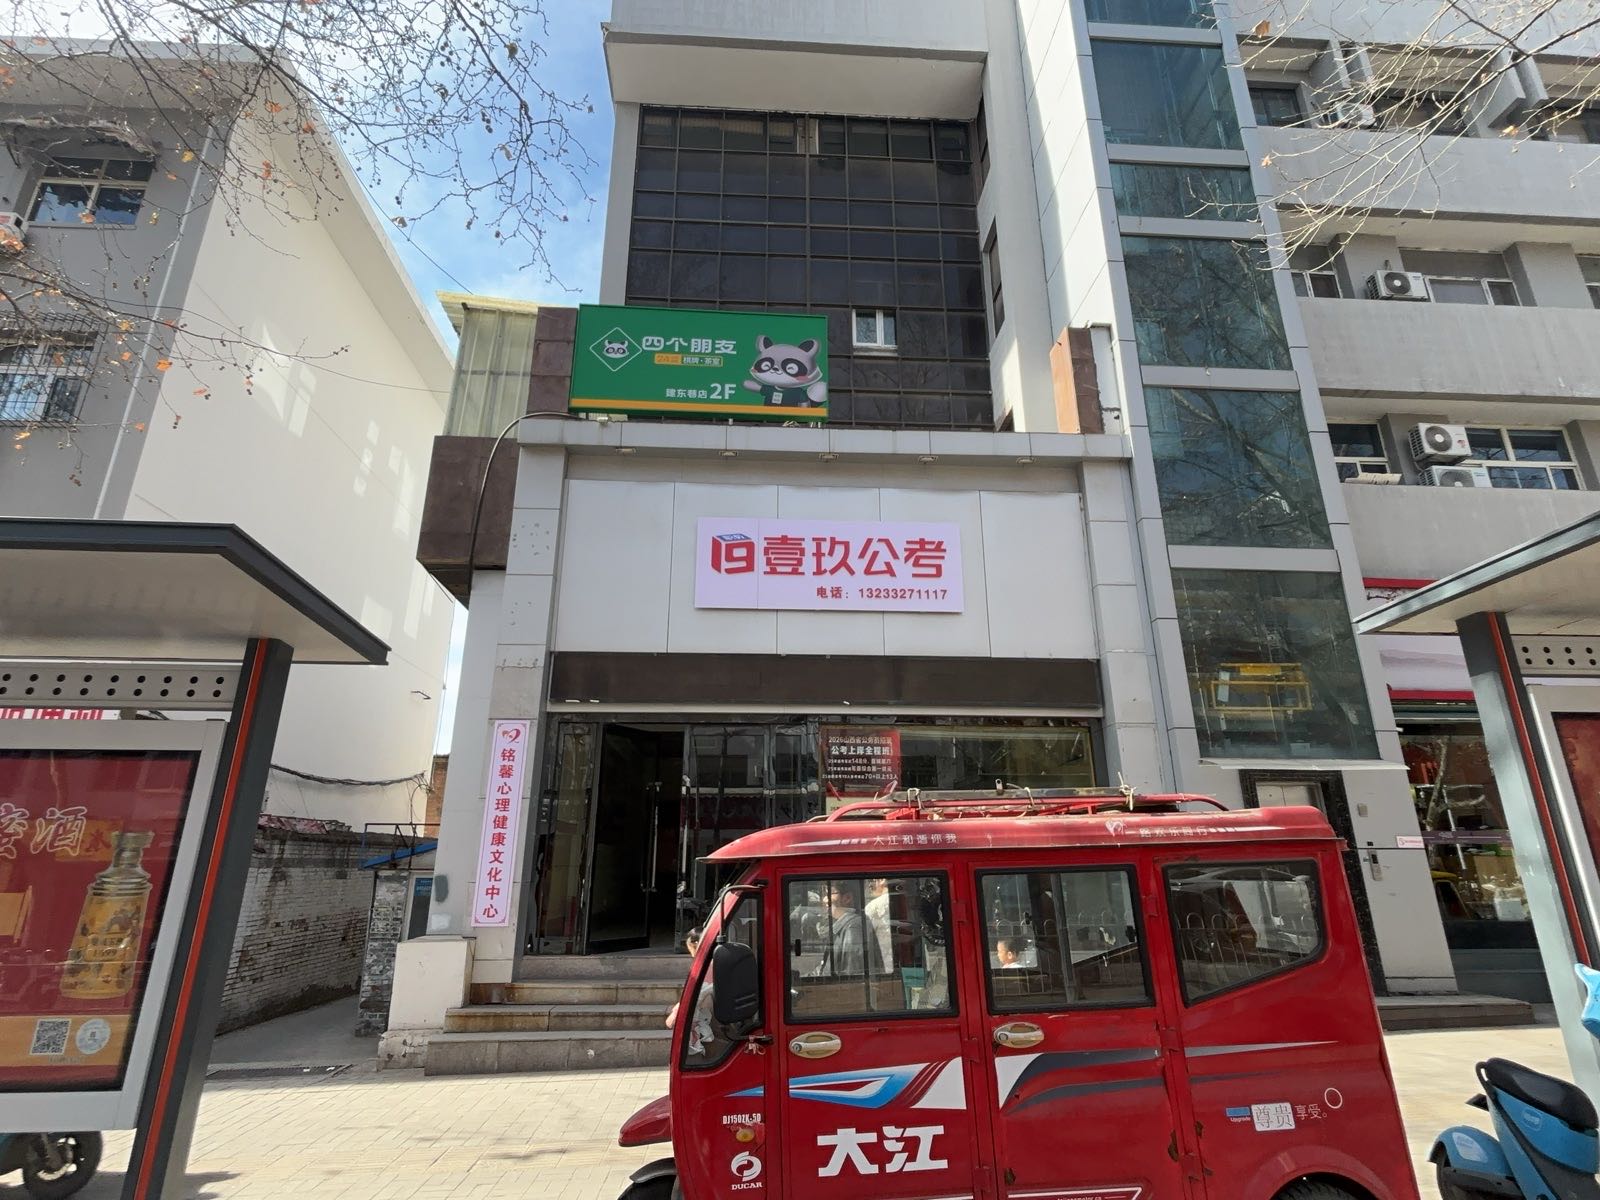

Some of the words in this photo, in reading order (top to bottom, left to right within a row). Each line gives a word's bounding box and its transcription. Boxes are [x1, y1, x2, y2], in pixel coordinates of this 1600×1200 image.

[641, 336, 737, 355] 四个朋友
[666, 388, 708, 399] 建东巷店
[710, 382, 737, 399] 2F
[763, 535, 947, 578] 壹玖公考
[858, 587, 948, 600] 13233271117
[482, 748, 516, 919] 铭馨心理健康文化中心
[873, 833, 957, 846] 大江和谐你我
[1255, 1104, 1293, 1128] 尊贵
[817, 1125, 949, 1177] 大江
[731, 1182, 763, 1191] DUCAR
